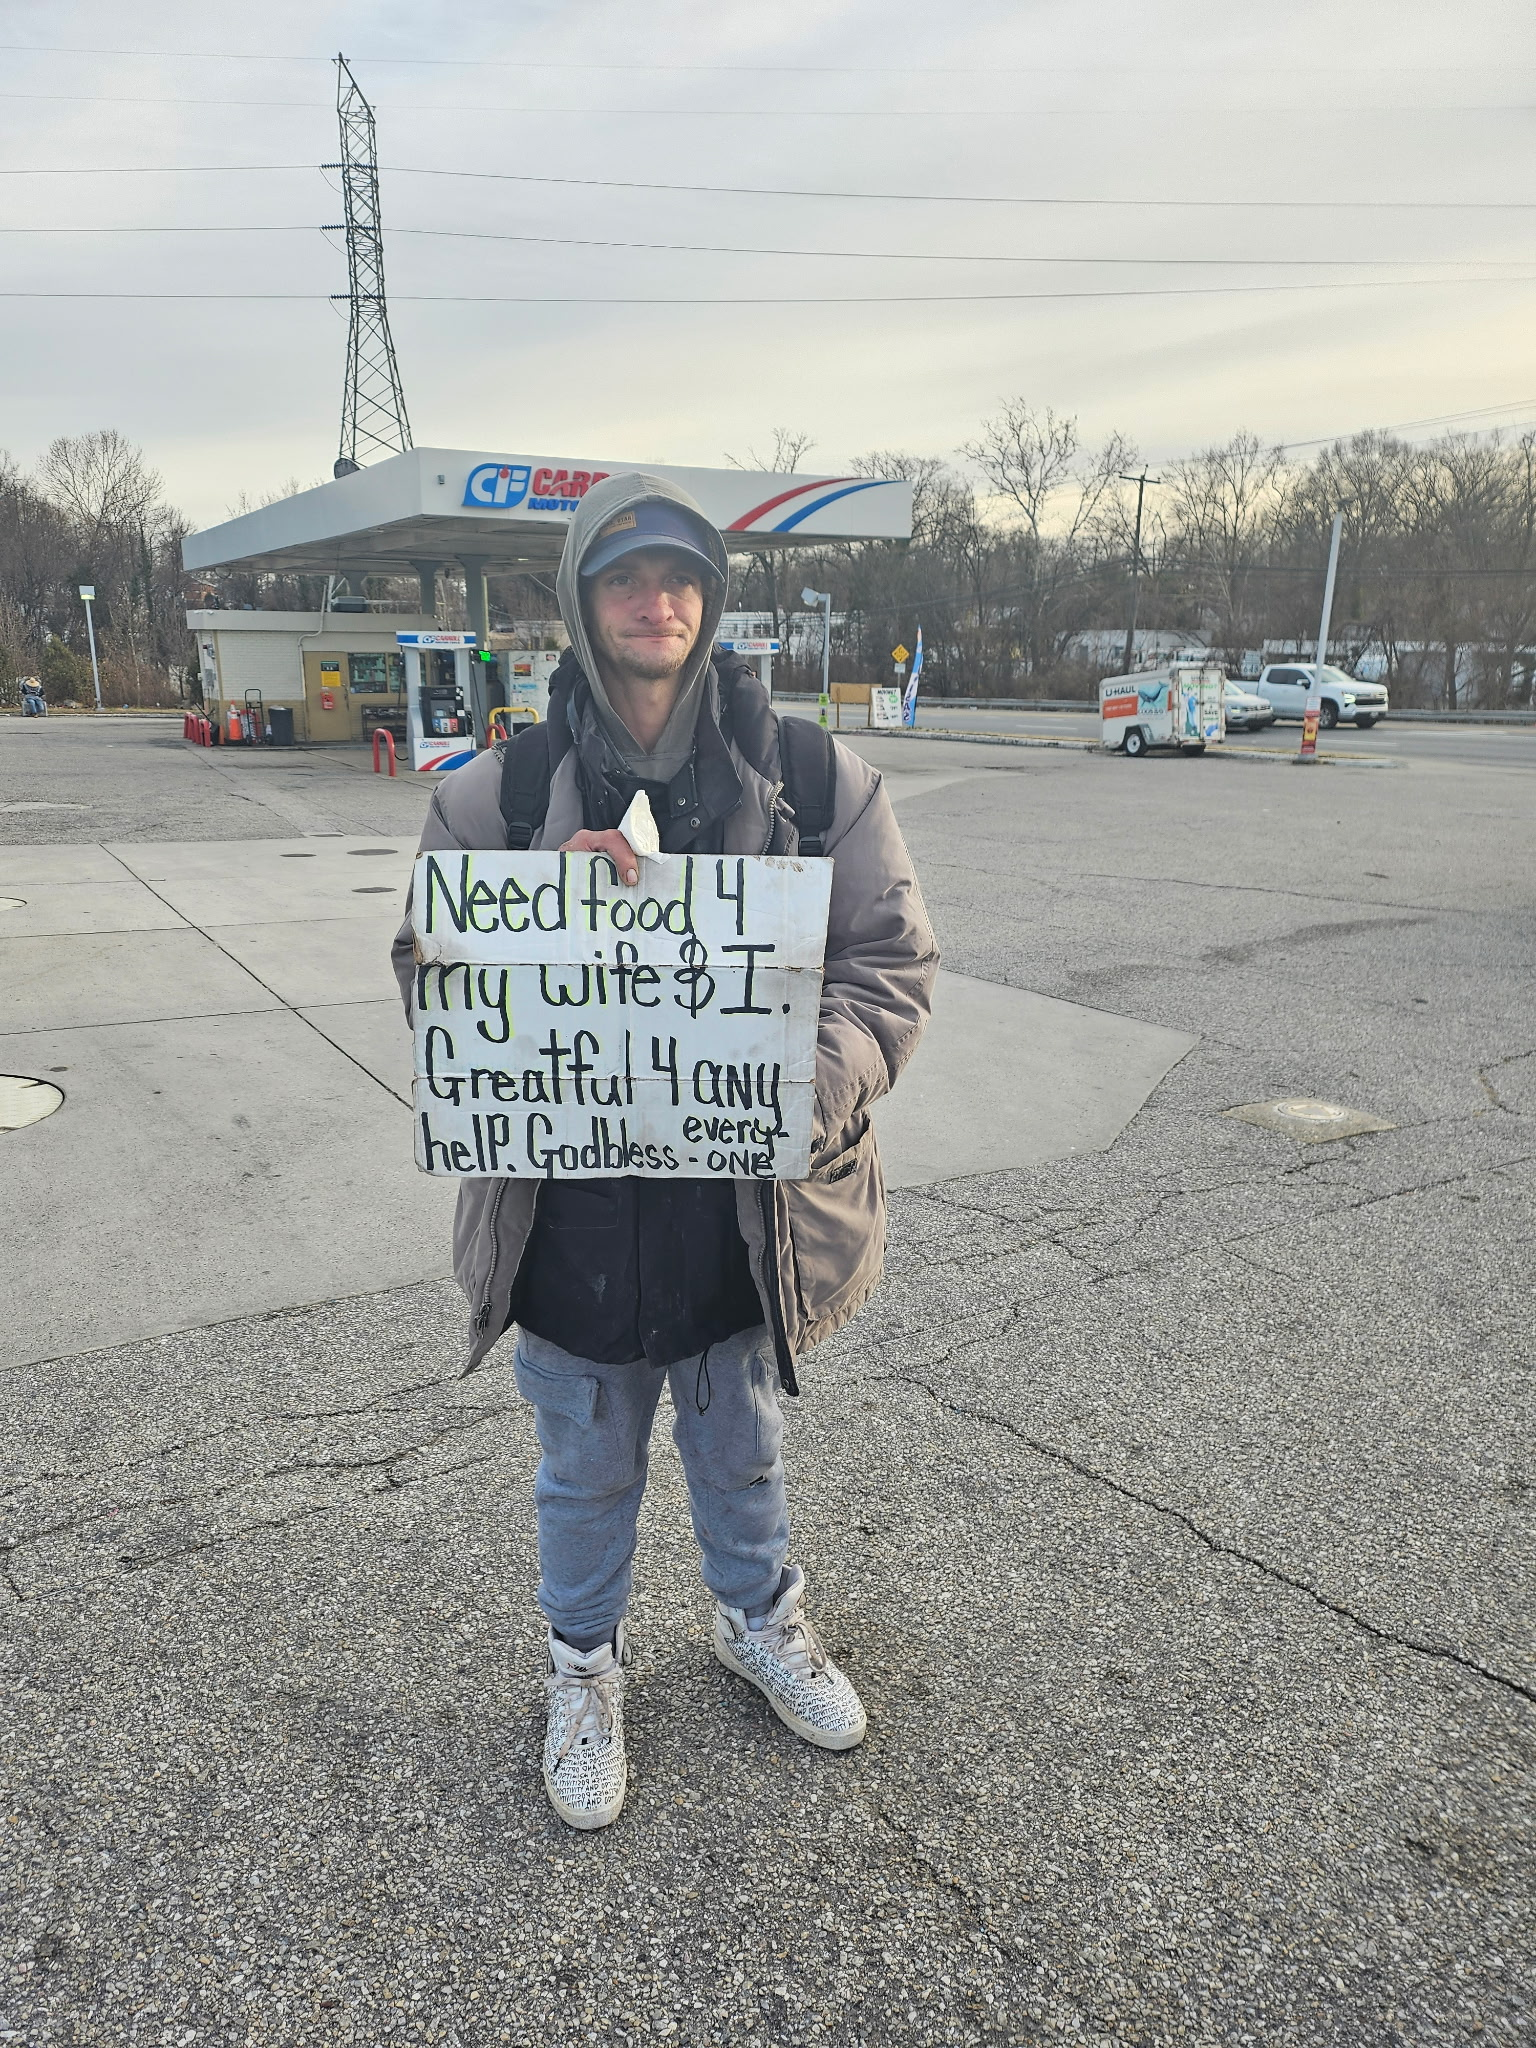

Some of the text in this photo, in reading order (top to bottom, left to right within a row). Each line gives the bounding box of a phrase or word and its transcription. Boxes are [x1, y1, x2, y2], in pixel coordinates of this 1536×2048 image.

[426, 852, 745, 936] Need food 4
[416, 961, 511, 1044] my
[538, 940, 662, 1008] wife
[425, 1025, 633, 1107] Greatful
[651, 1035, 680, 1107] 4
